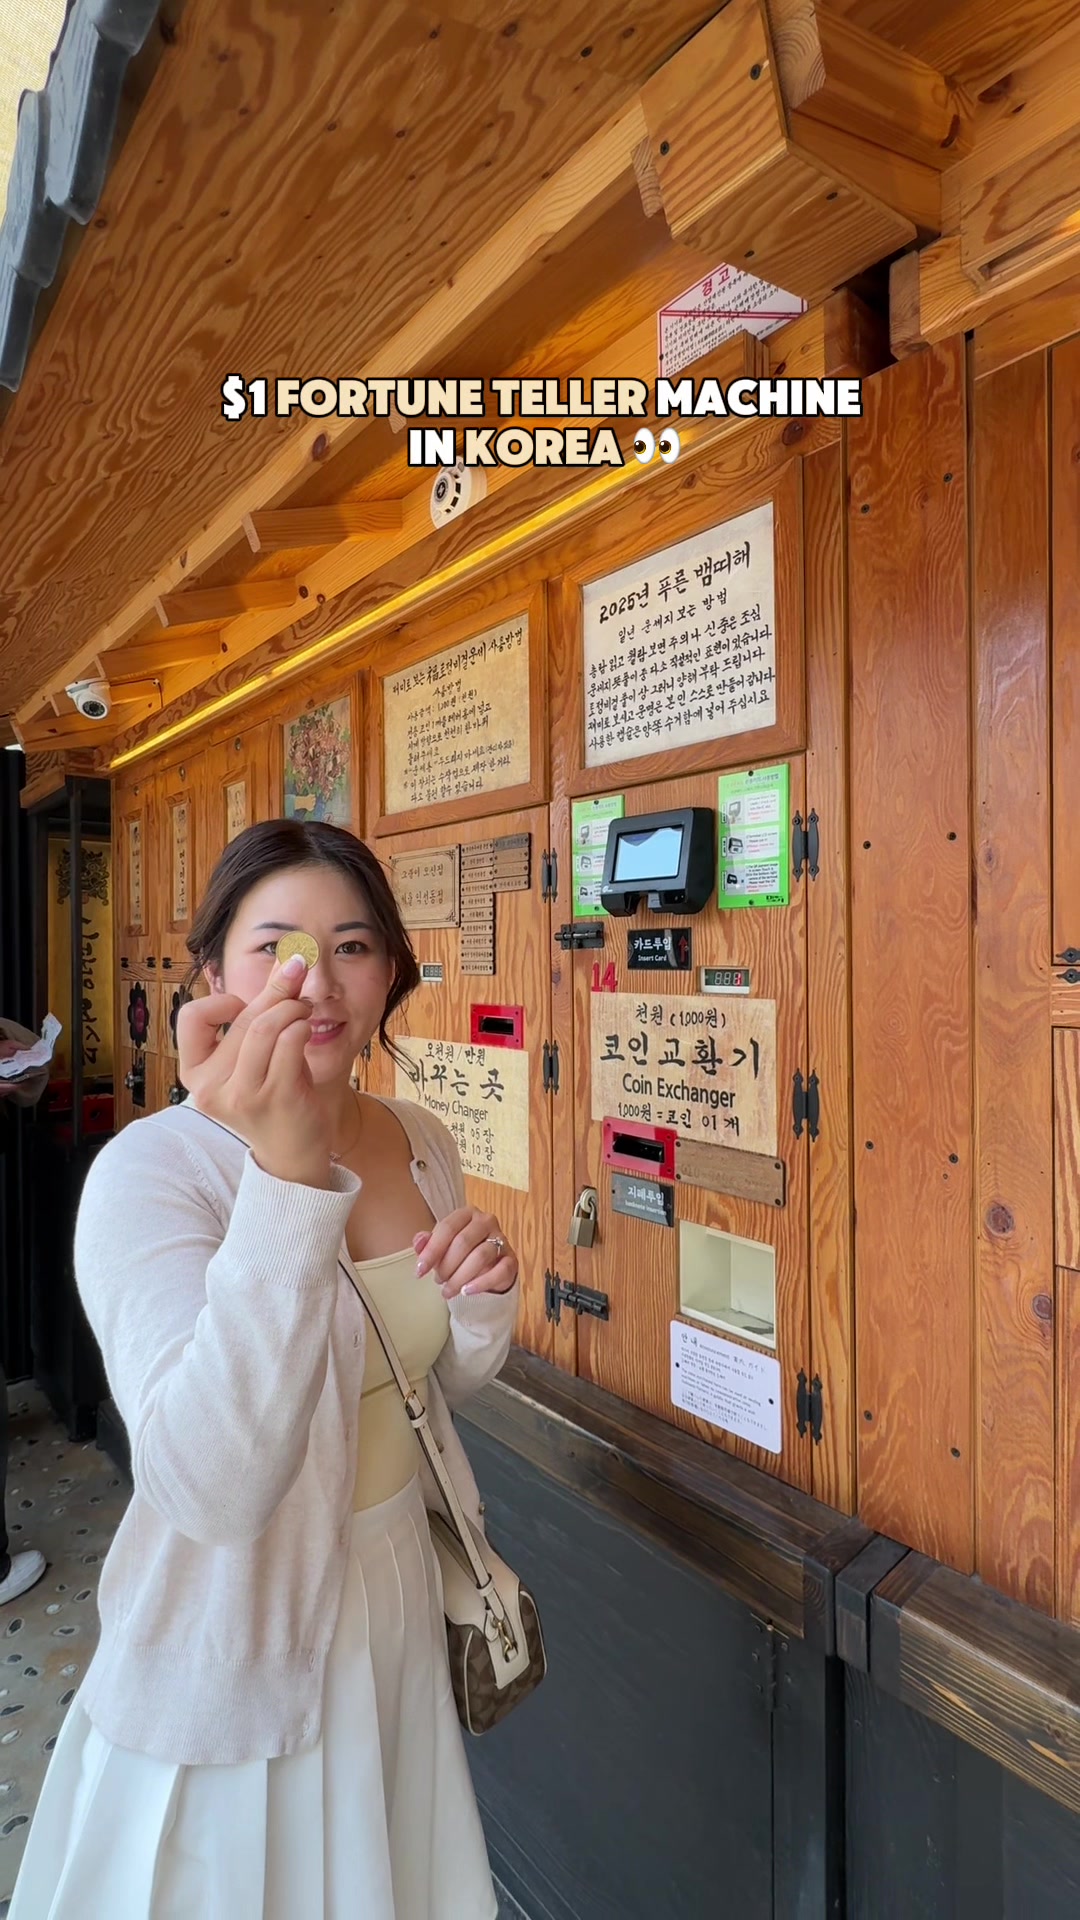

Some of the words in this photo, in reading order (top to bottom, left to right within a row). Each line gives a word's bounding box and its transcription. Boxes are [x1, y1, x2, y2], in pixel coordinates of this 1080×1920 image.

[599, 582, 649, 624] 2025년
[658, 569, 690, 603] 푸른
[693, 541, 751, 588] 뱀띠해
[618, 624, 635, 644] 일년
[641, 610, 673, 634] 운세지
[676, 604, 697, 622] 보는
[702, 587, 727, 611] 방법
[648, 638, 666, 658] 보면
[669, 628, 701, 650] 주의나
[704, 616, 737, 637] 신중은
[740, 603, 761, 626] 조심
[650, 661, 668, 675] 다소
[732, 624, 773, 652] 있습니다
[677, 669, 697, 688] 양해
[699, 662, 720, 680] 부탁
[722, 646, 766, 672] 드립니다
[690, 684, 715, 703] 스스로
[716, 674, 744, 695] 만들어
[634, 936, 672, 952] 카드투입
[638, 954, 654, 963] Insert
[655, 954, 667, 962] Card
[591, 960, 618, 993] 14
[635, 1002, 663, 1026] 천원
[425, 1041, 454, 1063] 오천원
[464, 1047, 486, 1067] 만원
[600, 1031, 648, 1066] 코인
[658, 1035, 759, 1080] 교환기
[409, 1059, 469, 1096] 바꾸는
[480, 1068, 505, 1102] 곳
[622, 1073, 653, 1096] Coin
[657, 1077, 736, 1109] Exchanger
[423, 1094, 450, 1116] Money
[452, 1100, 488, 1123] Changer
[666, 1108, 692, 1128] 코인
[723, 1115, 740, 1137] 개
[472, 1143, 481, 1156] 10
[627, 1185, 665, 1206] 지폐투입
